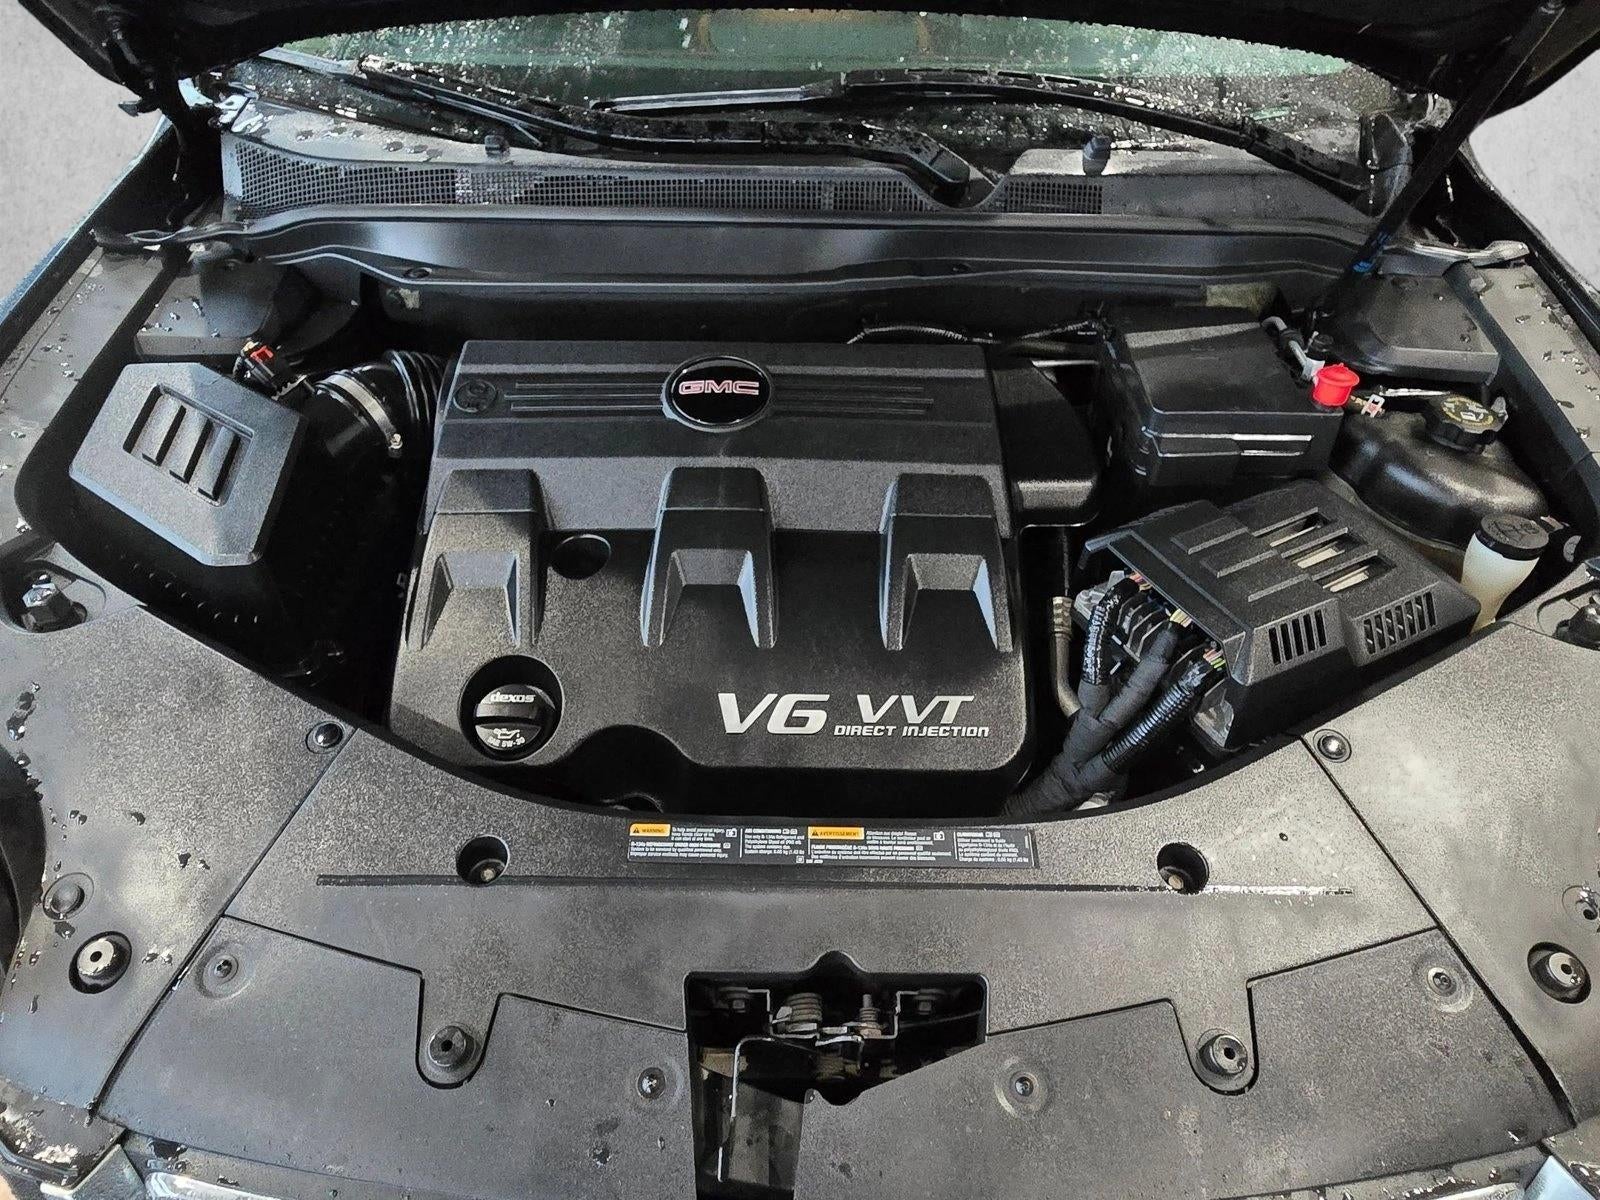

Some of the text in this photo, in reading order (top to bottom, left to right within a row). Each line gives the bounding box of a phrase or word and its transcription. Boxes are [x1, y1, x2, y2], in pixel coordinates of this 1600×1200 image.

[679, 380, 759, 395] GMC
[490, 691, 535, 703] dexos
[718, 693, 975, 734] V6 VVT
[834, 726, 990, 738] DIRECT INJECTION
